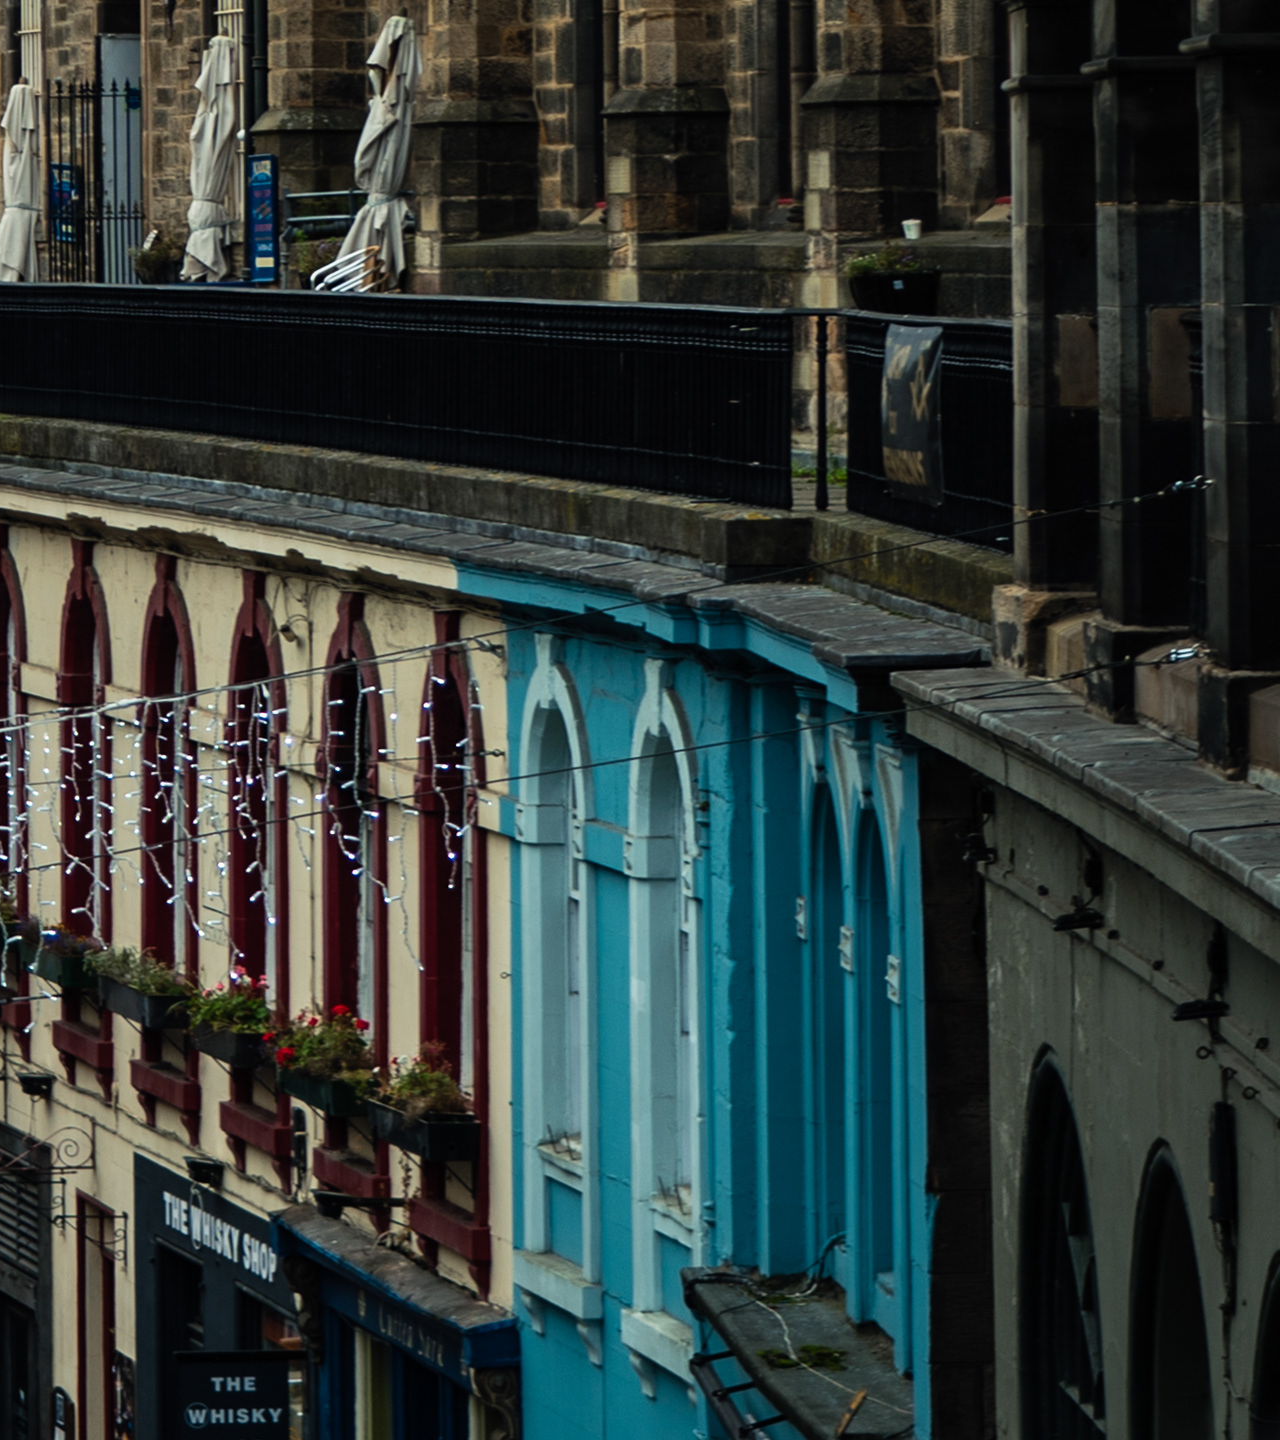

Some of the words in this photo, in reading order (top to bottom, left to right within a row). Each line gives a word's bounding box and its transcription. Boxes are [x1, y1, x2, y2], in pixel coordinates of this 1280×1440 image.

[162, 1190, 189, 1236] THE
[190, 1203, 240, 1263] WHISKY
[242, 1232, 278, 1283] SHOP
[210, 1376, 257, 1392] THE
[187, 1407, 283, 1425] WHISKY
